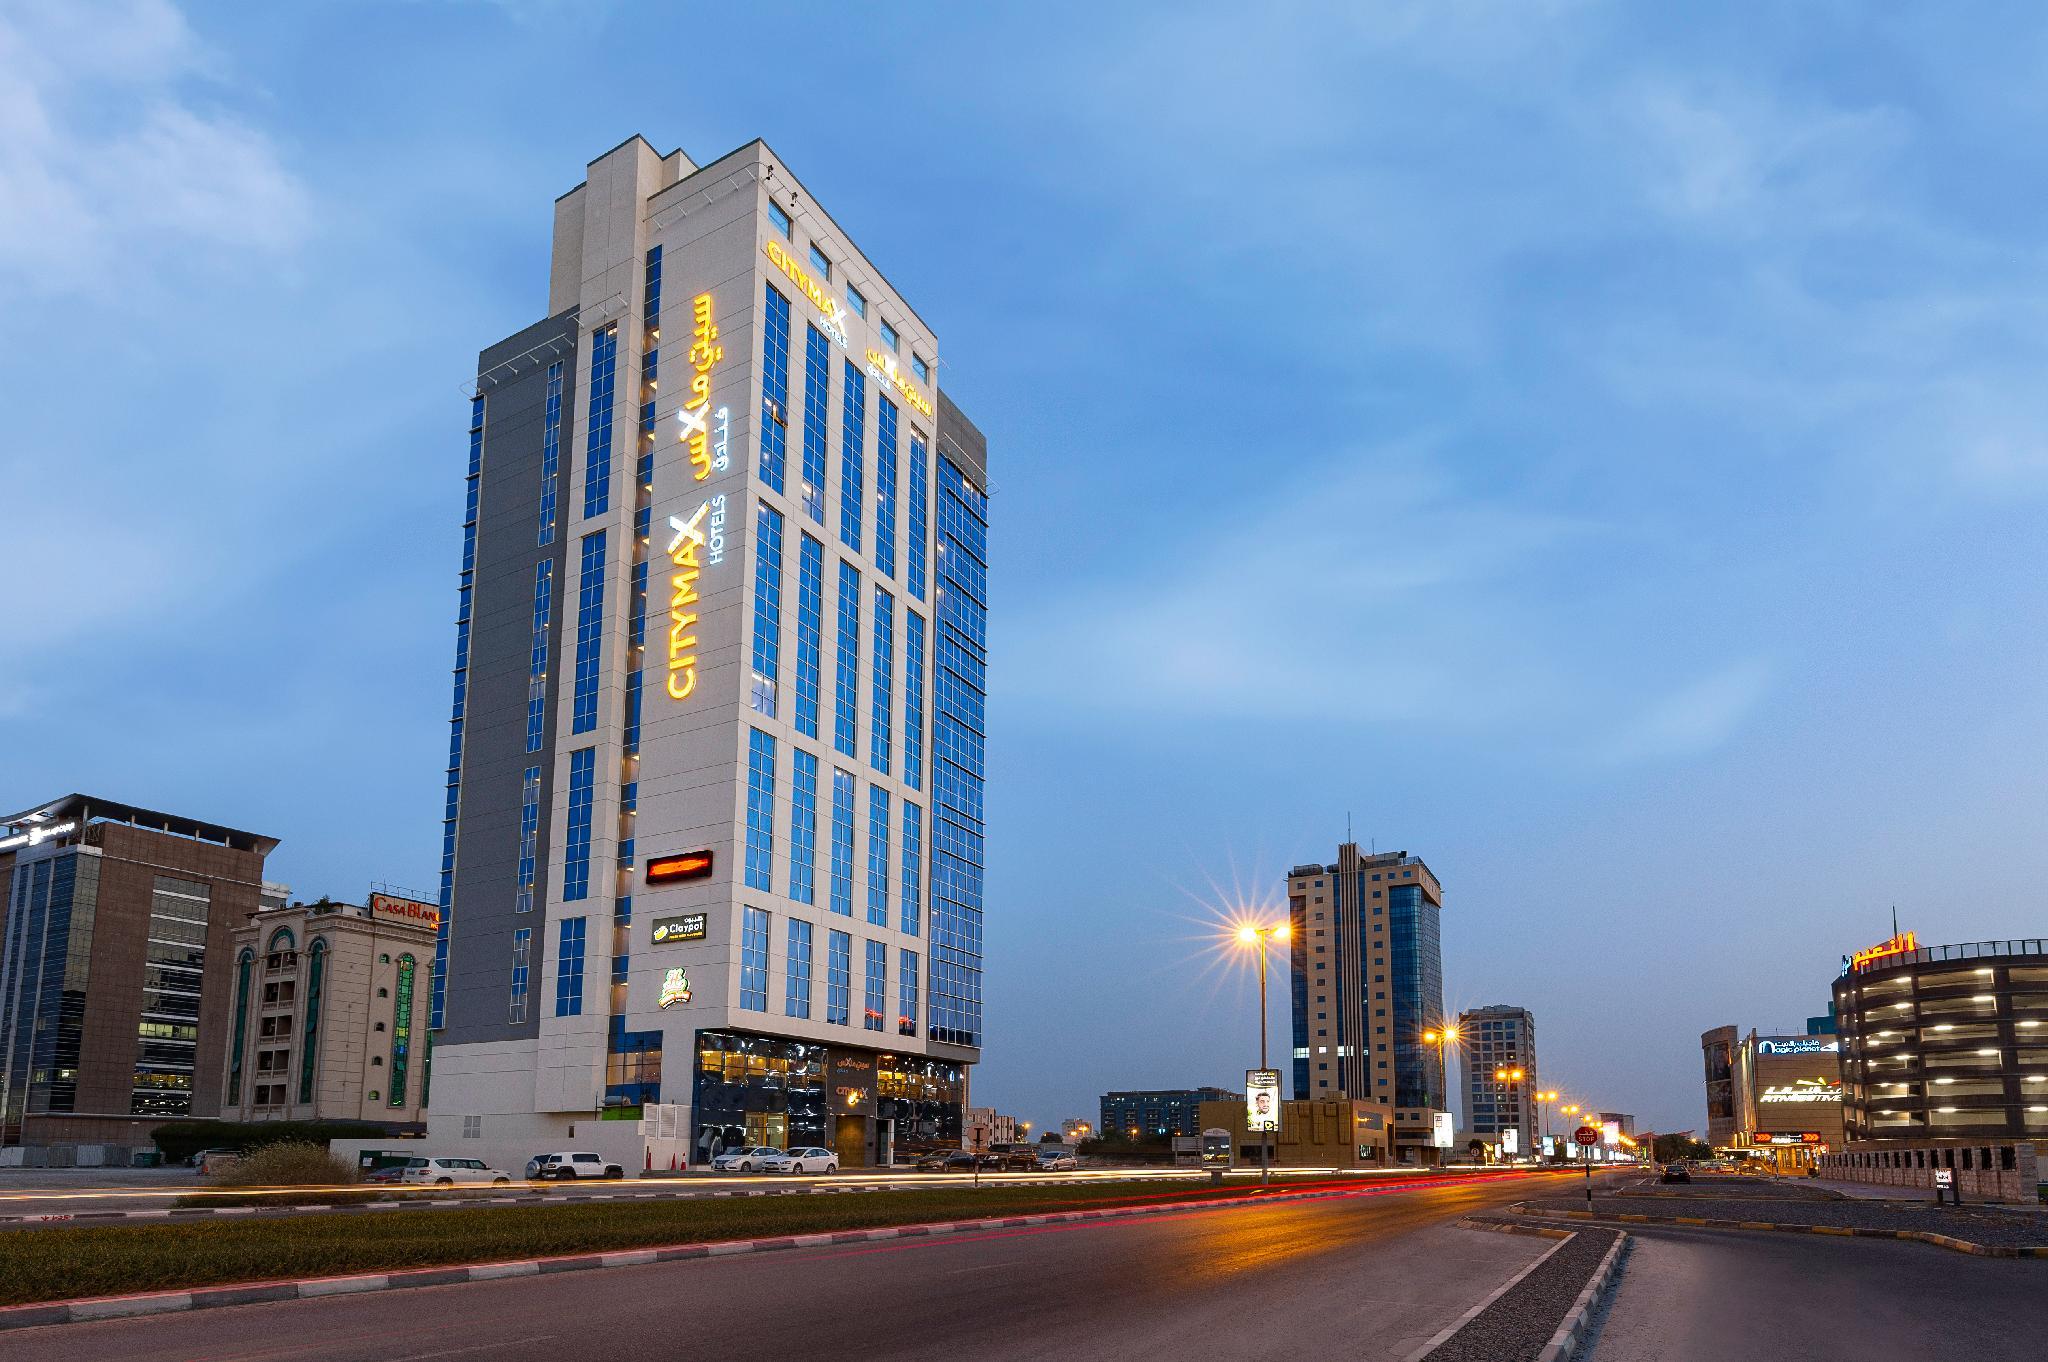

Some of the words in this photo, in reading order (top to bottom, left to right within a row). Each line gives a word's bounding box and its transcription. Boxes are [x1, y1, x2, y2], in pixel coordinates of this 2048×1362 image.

[767, 241, 847, 336] CITYMAX
[709, 494, 726, 565] HOTELS
[667, 500, 710, 700] CITYMAX
[1853, 930, 1915, 971] النعيم
